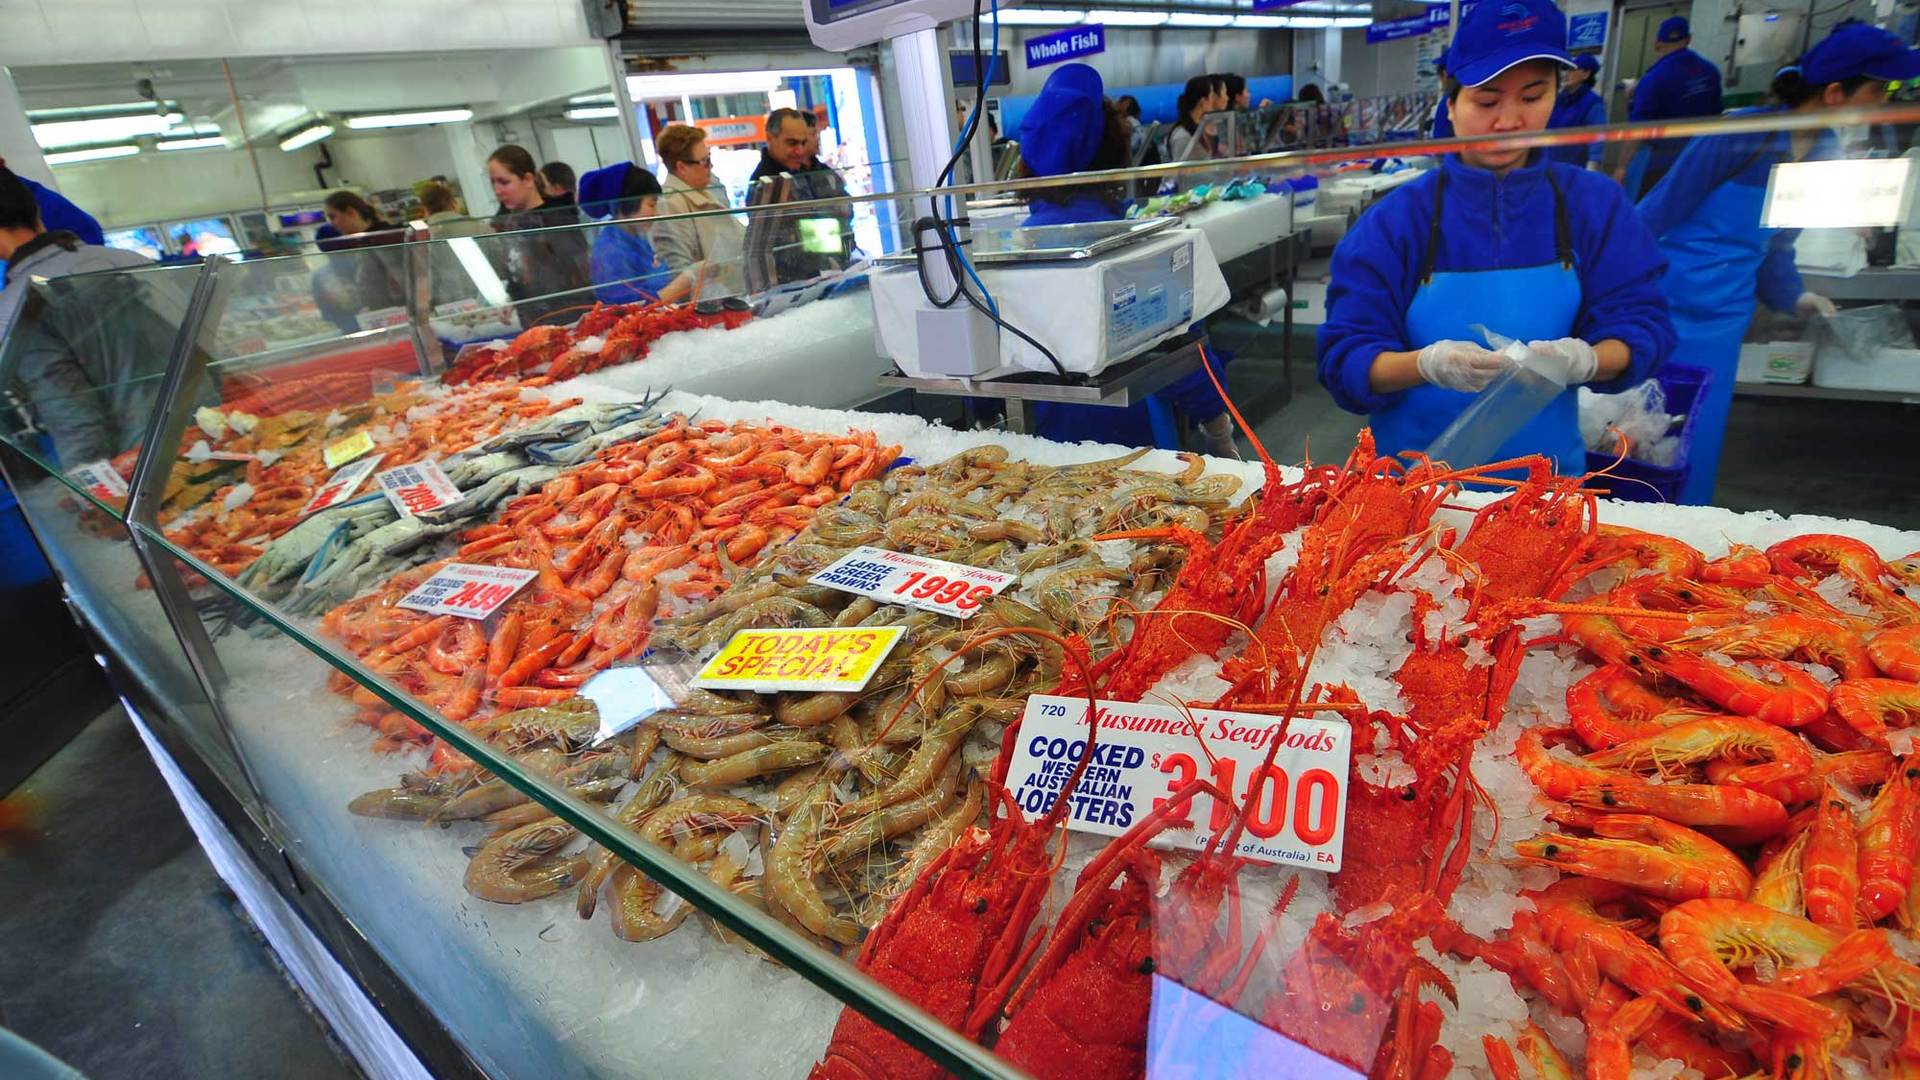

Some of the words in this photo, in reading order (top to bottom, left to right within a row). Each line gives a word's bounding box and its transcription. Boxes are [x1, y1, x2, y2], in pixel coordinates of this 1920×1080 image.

[1030, 39, 1069, 60] Whole
[1070, 31, 1099, 52] Fish
[834, 566, 888, 582] GREEN
[845, 559, 898, 575] LARGE
[815, 572, 881, 591] PRAWNS
[740, 633, 877, 654] TODAY'S
[716, 656, 850, 678] SPECIAL
[1041, 704, 1066, 717] 720
[1075, 705, 1206, 738] Musumeci
[1028, 735, 1145, 769] COOKED
[1041, 760, 1121, 783] WESERN
[1014, 787, 1135, 828] LOBTERS
[1242, 843, 1255, 853] of
[1256, 846, 1311, 862] Australia)
[1316, 851, 1335, 864] EA
